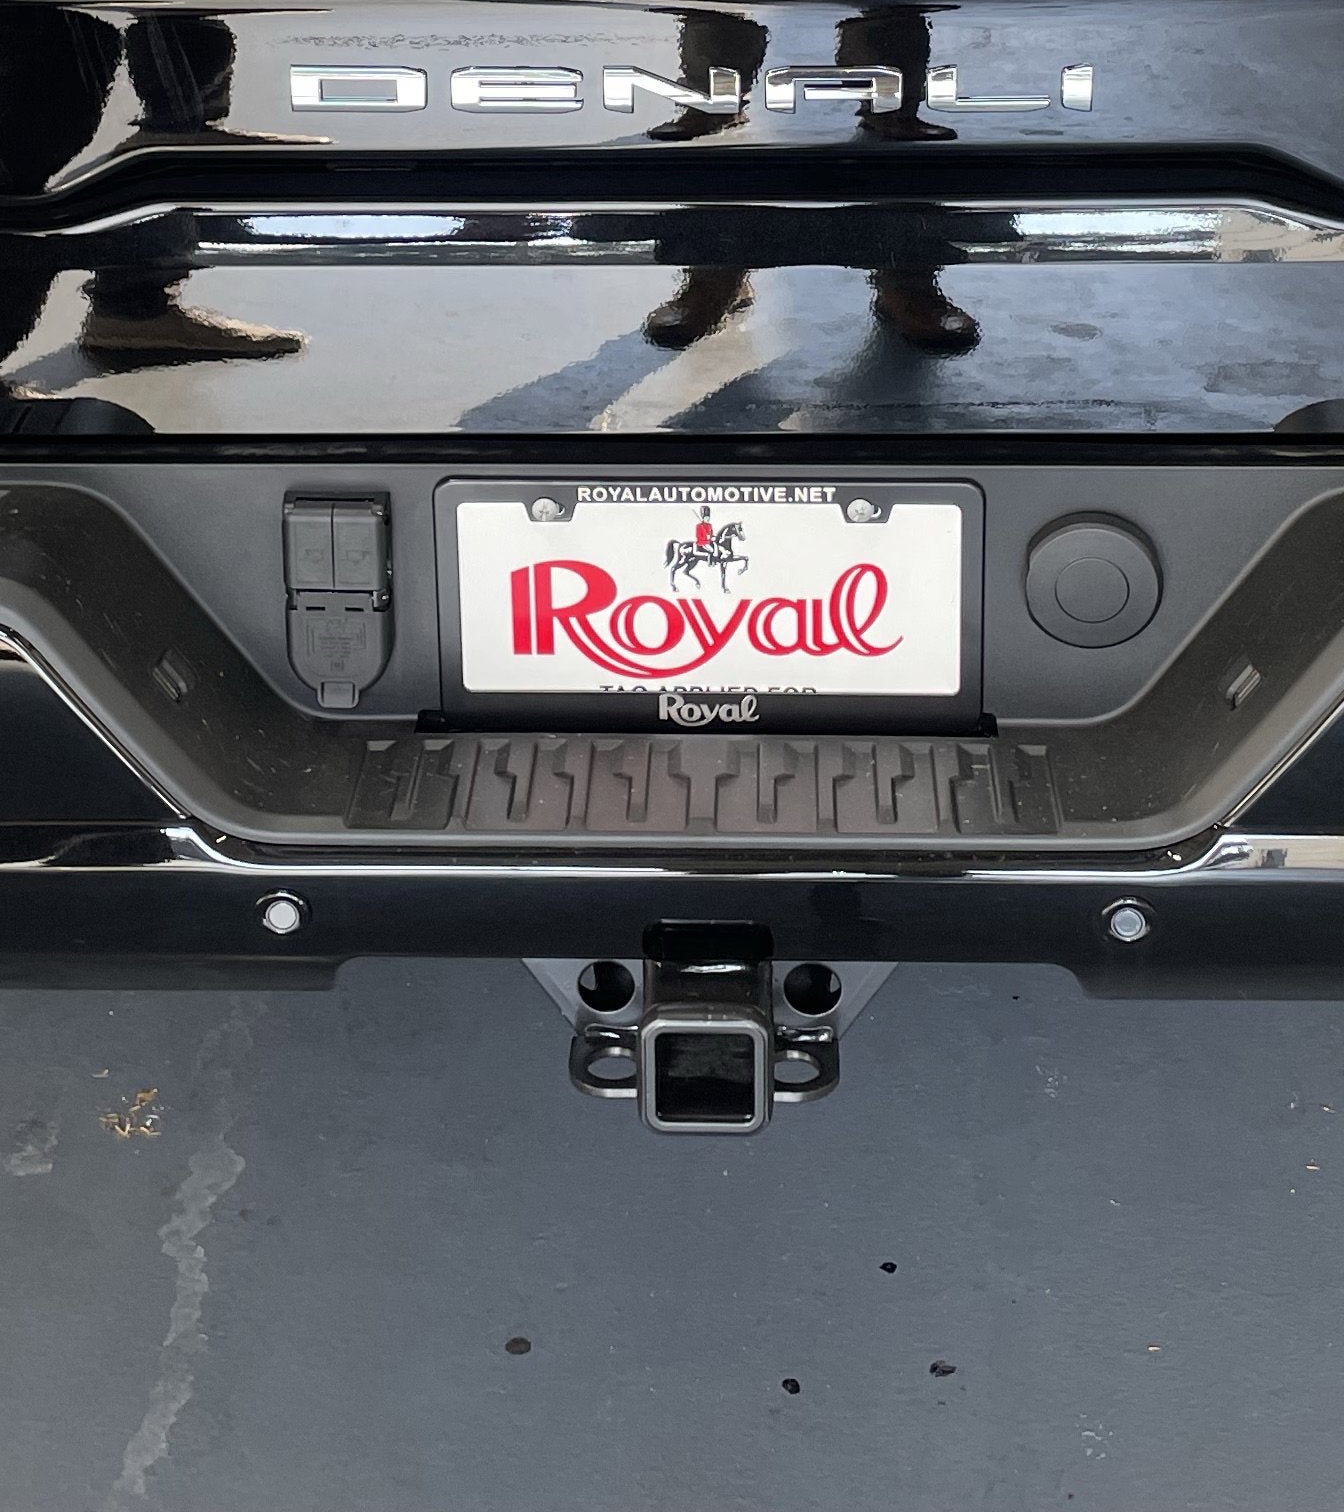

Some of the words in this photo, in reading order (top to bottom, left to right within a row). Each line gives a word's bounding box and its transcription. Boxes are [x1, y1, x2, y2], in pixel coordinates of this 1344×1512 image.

[290, 62, 1094, 113] DENALI
[577, 486, 836, 502] ROYALAUTOMOTIVE.NET
[510, 559, 904, 678] Royal
[658, 692, 760, 727] Royal
